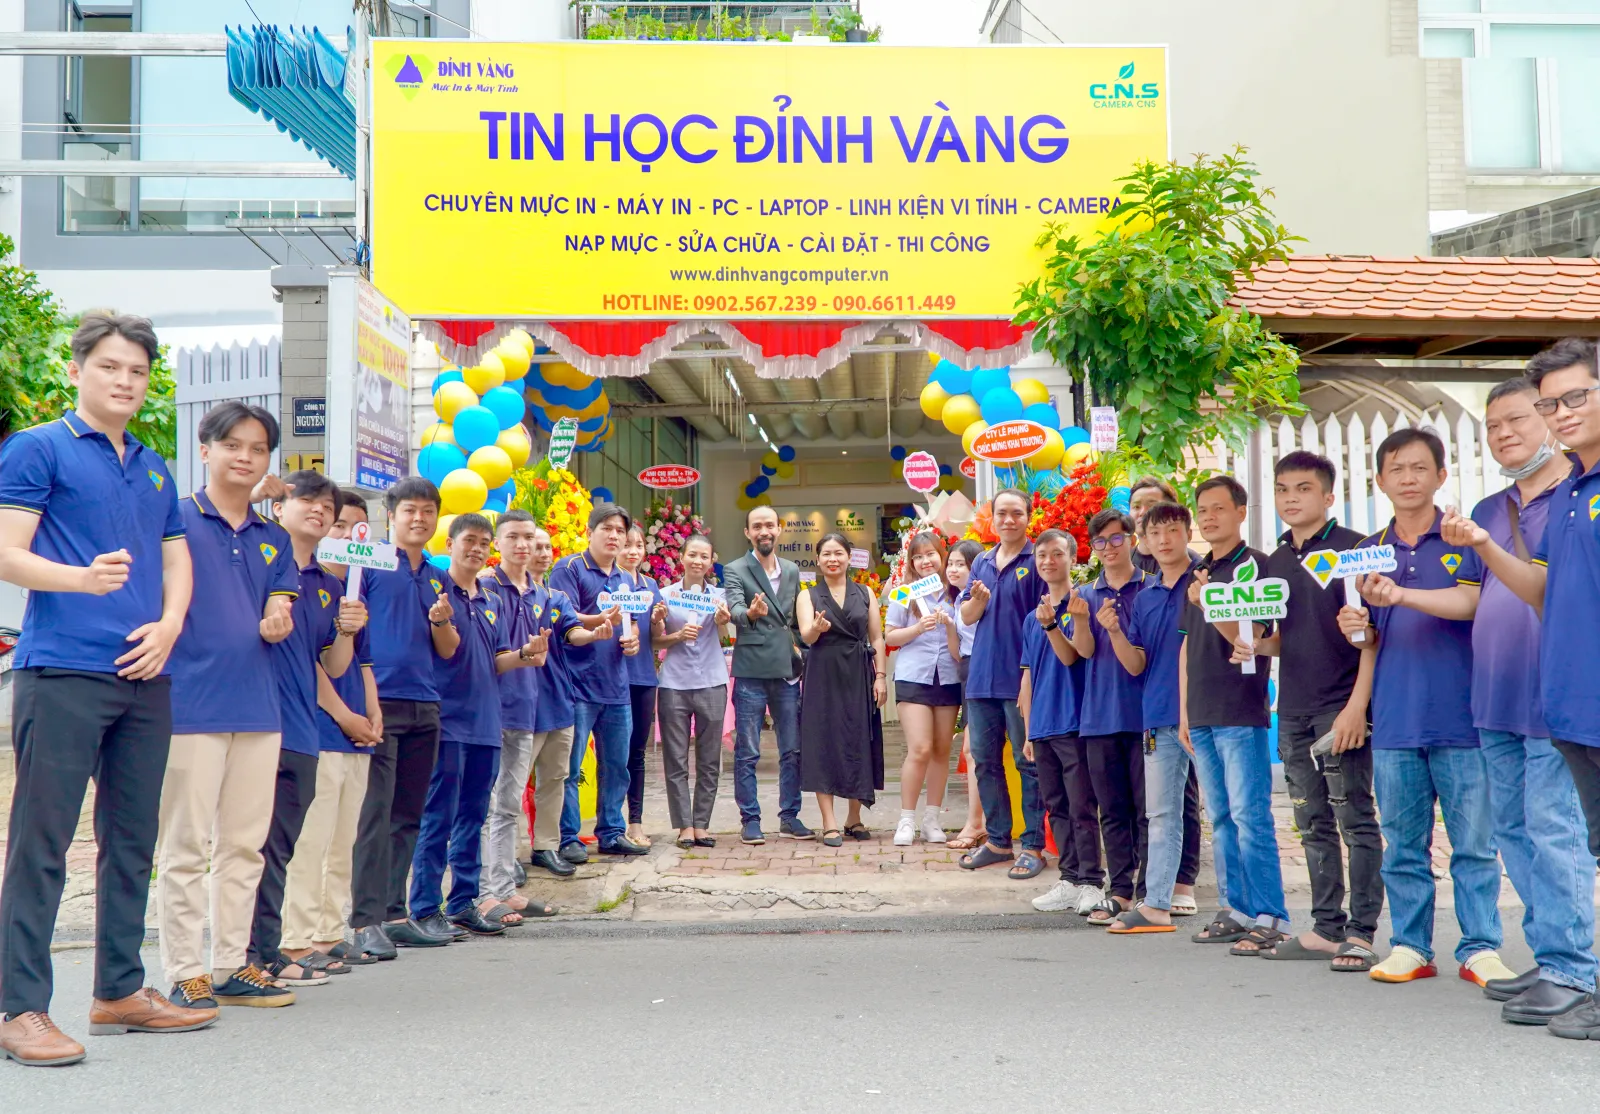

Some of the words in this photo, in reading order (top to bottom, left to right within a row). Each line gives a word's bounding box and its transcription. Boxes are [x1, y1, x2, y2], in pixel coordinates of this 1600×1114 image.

[438, 57, 471, 77] ĐỈNH
[477, 57, 514, 79] VÀNG
[452, 83, 462, 91] In
[1089, 83, 1159, 99] C.N.S
[1136, 100, 1156, 108] CNS
[479, 111, 564, 161] TIN
[584, 113, 719, 172] HỌC
[733, 95, 873, 163] ĐỈNH
[890, 100, 1070, 164] VÀNG
[424, 191, 513, 212] CHUYÊN
[520, 194, 570, 217] MỰC
[576, 197, 596, 214] IN
[617, 193, 664, 215] MÁY
[672, 198, 691, 215] IN
[712, 199, 739, 216] PC
[760, 199, 829, 216] LAPTOP
[850, 199, 891, 216] LINH
[898, 194, 944, 219] KIỆN
[950, 198, 969, 215] VI
[976, 194, 1017, 215] TÍNH
[1038, 197, 1123, 215] CAMERA
[565, 235, 605, 255] NẠP
[611, 233, 659, 255] MỰC
[678, 229, 718, 253] SỬA
[723, 232, 781, 253] CHỮA
[800, 232, 835, 253] CÀI
[842, 232, 878, 256] ĐẶT
[898, 236, 924, 253] THI
[930, 232, 990, 253] CÔNG
[670, 266, 889, 286] www.dinhvangcomputer.vn
[602, 294, 689, 311] HOTLINE:
[694, 295, 817, 311] 0902.567.239
[833, 295, 956, 311] 090.6611.449
[304, 403, 318, 411] CÔNG
[985, 429, 998, 439] CTY
[977, 442, 991, 453] CHÚC
[1007, 439, 1020, 449] KHAI
[347, 543, 374, 557] CNS
[778, 541, 801, 552] THIẾT
[320, 552, 333, 560] 157
[681, 593, 710, 603] CHECK-IN
[1205, 584, 1283, 605] C.N.S
[1209, 608, 1231, 618] CNS
[1234, 606, 1281, 617] CAMERA
